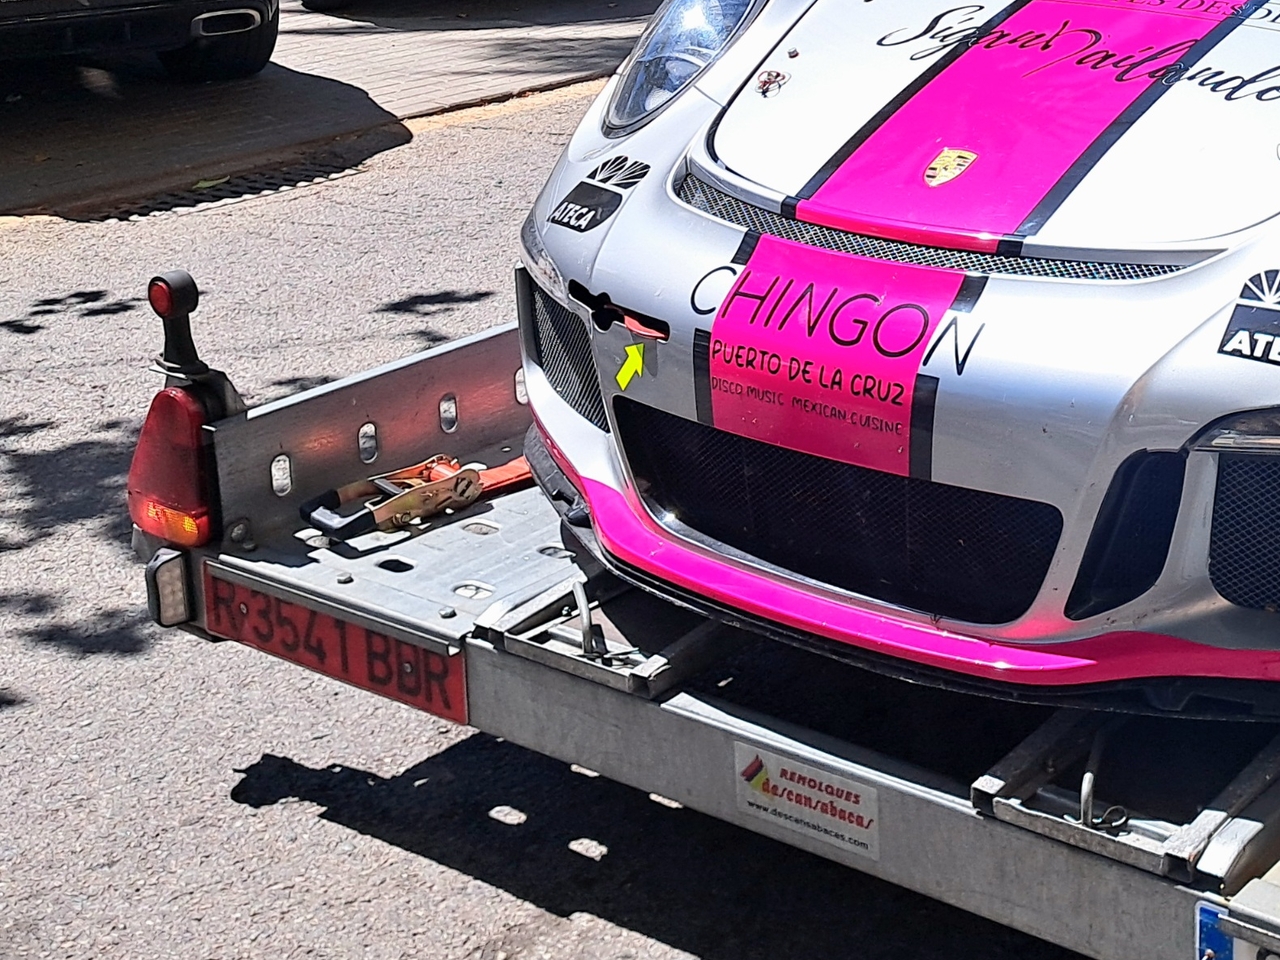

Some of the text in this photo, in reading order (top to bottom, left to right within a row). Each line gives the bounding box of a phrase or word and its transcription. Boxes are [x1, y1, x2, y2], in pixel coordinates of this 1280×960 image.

[549, 201, 596, 230] ATECA
[690, 265, 985, 376] CHINGON
[711, 339, 906, 406] PUERTO DE LA CRUZ
[711, 377, 904, 435] DISCO MUSIC MEXICAN CUISINE
[212, 575, 239, 634] R
[250, 589, 349, 674] 3541
[779, 768, 862, 806] REMOLQUES
